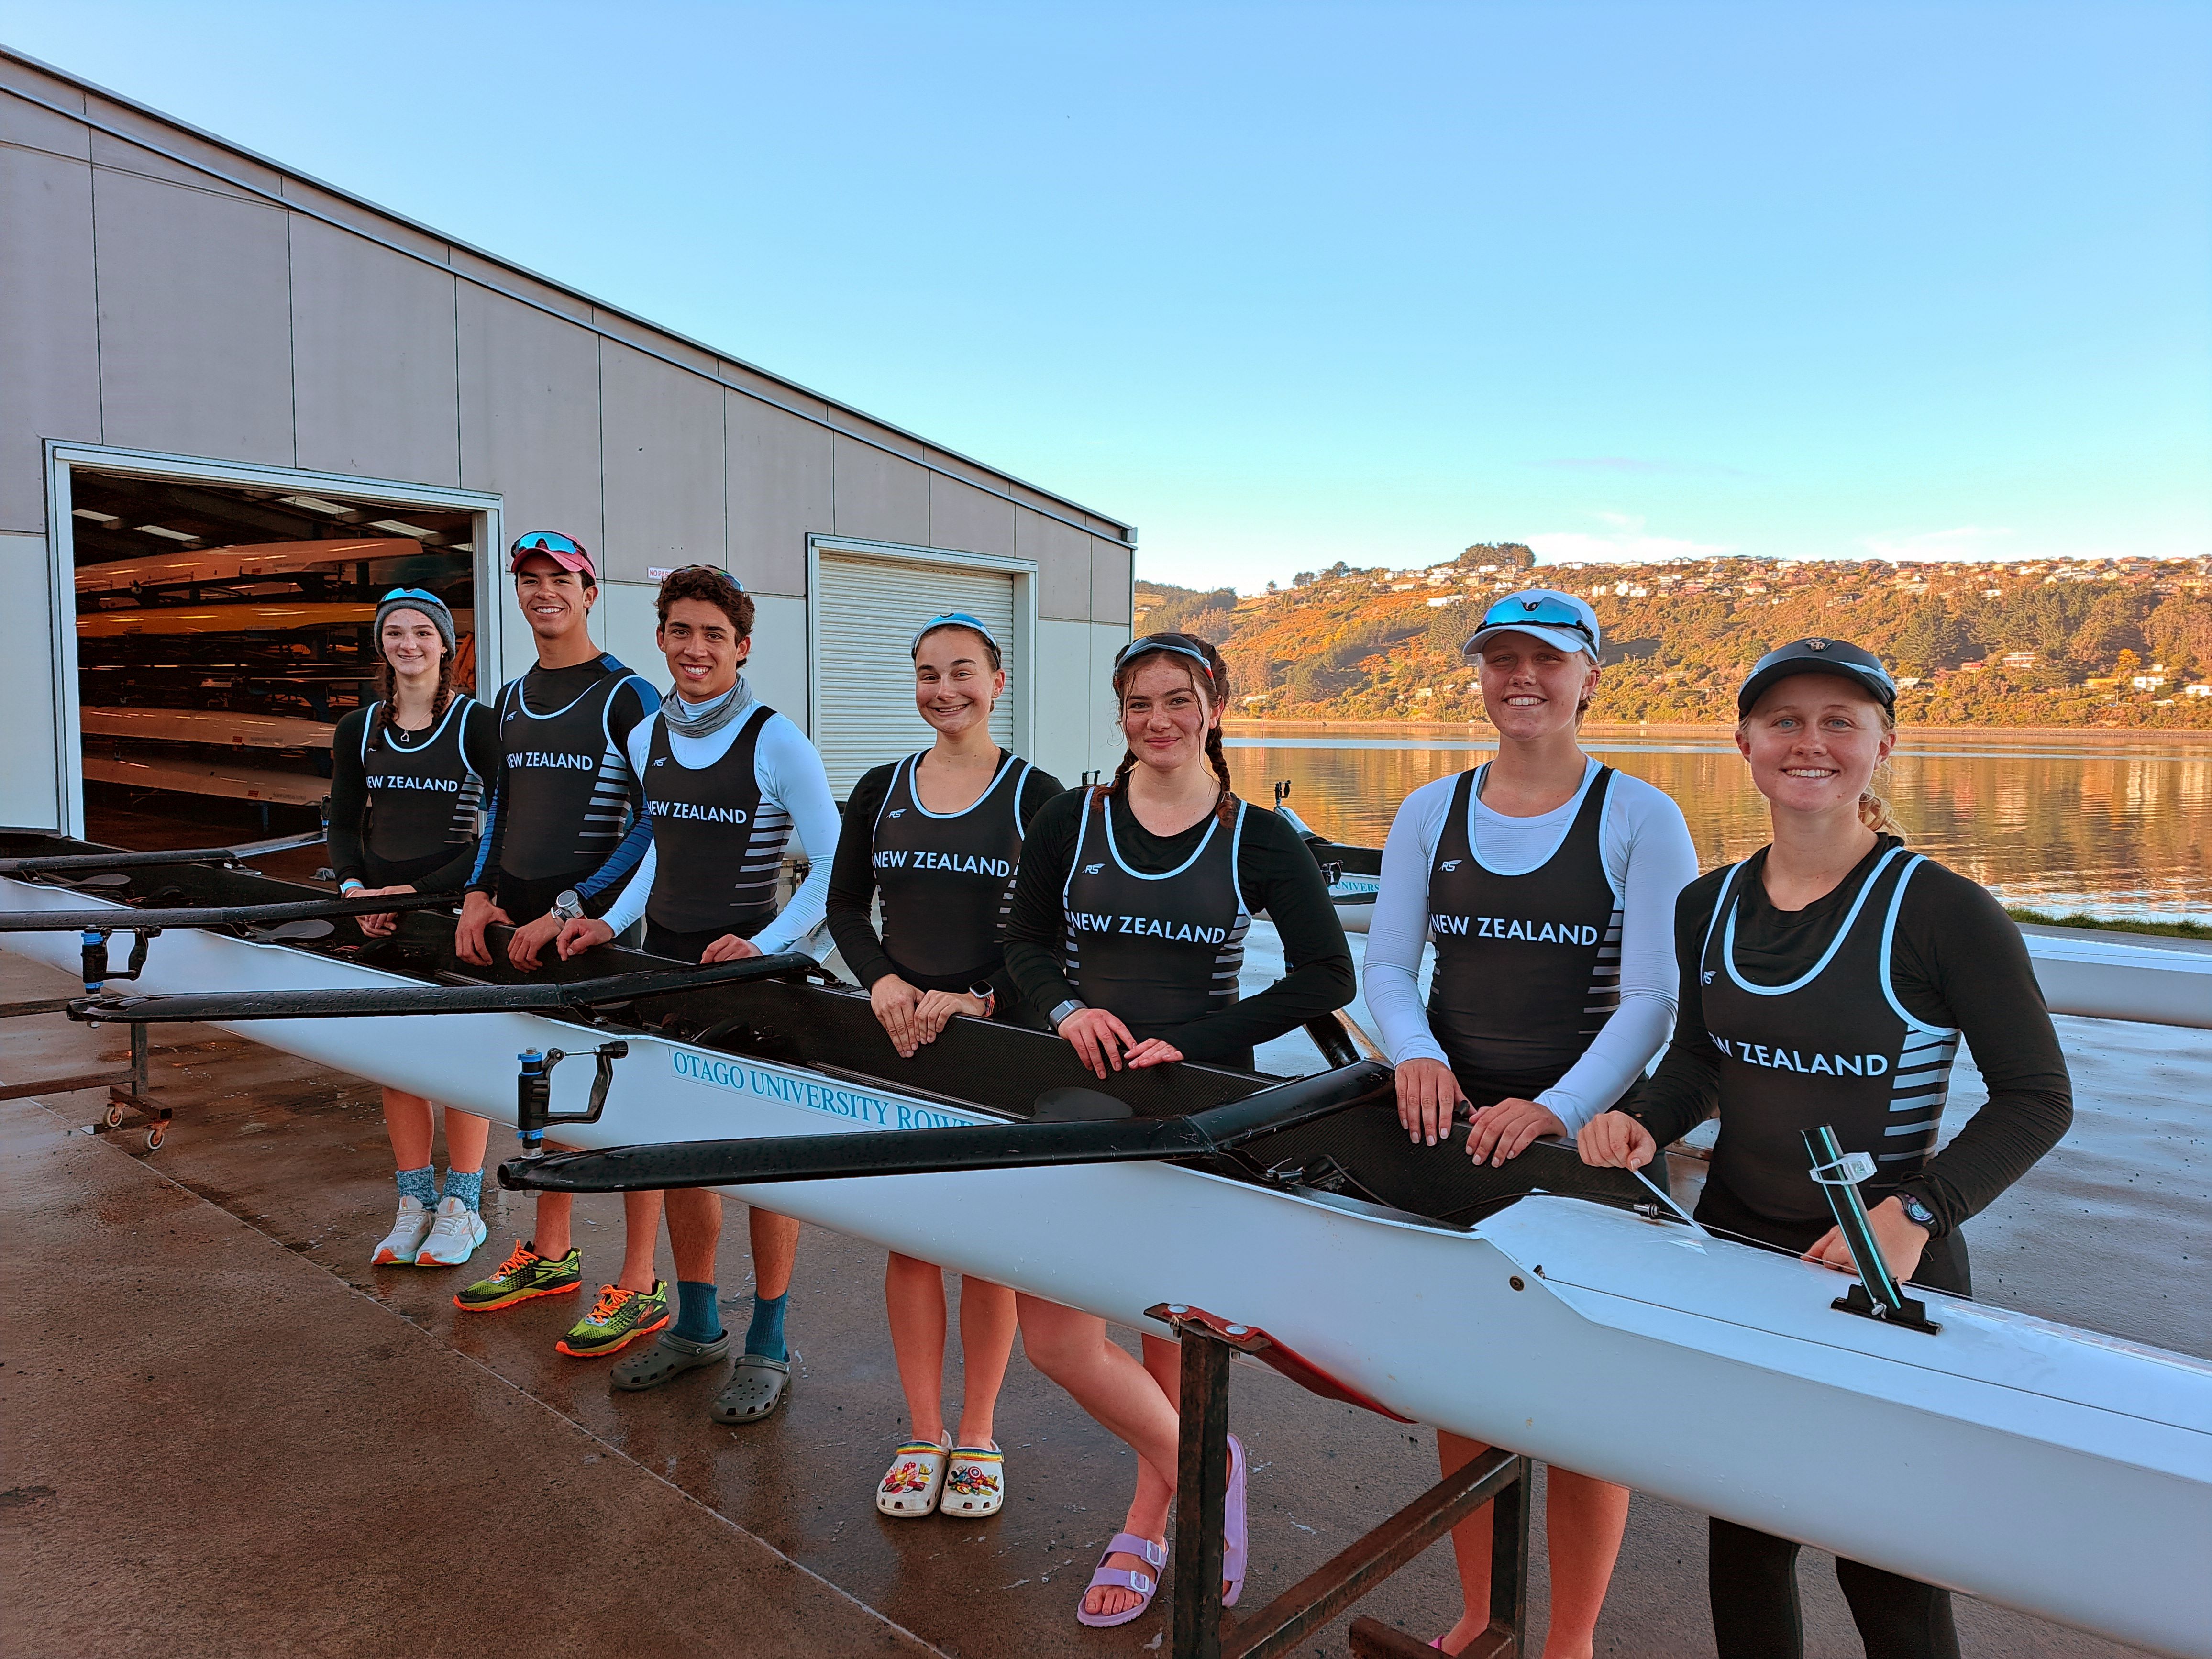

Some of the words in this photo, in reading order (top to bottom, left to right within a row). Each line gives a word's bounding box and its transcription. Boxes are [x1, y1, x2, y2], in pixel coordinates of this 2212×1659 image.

[526, 752, 593, 771] ZEALAND
[653, 757, 667, 766] RS
[387, 775, 458, 793] ZEALAND
[672, 802, 747, 824] ZEALAND
[888, 809, 907, 818] RS
[874, 850, 908, 869] NEW
[912, 851, 1009, 878] ZEALAND
[1085, 863, 1104, 874] RS
[1441, 860, 1460, 872] RS
[1335, 881, 1380, 892] UNIVERS
[1070, 911, 1112, 932] NEW
[1118, 916, 1226, 944] ZEALAND
[1431, 913, 1470, 936] NEW
[1477, 917, 1598, 946] ZEALAND
[1736, 1041, 1888, 1077] ZEALAND
[674, 1051, 745, 1089] OTAGO
[749, 1070, 889, 1126] UNIVERSITY
